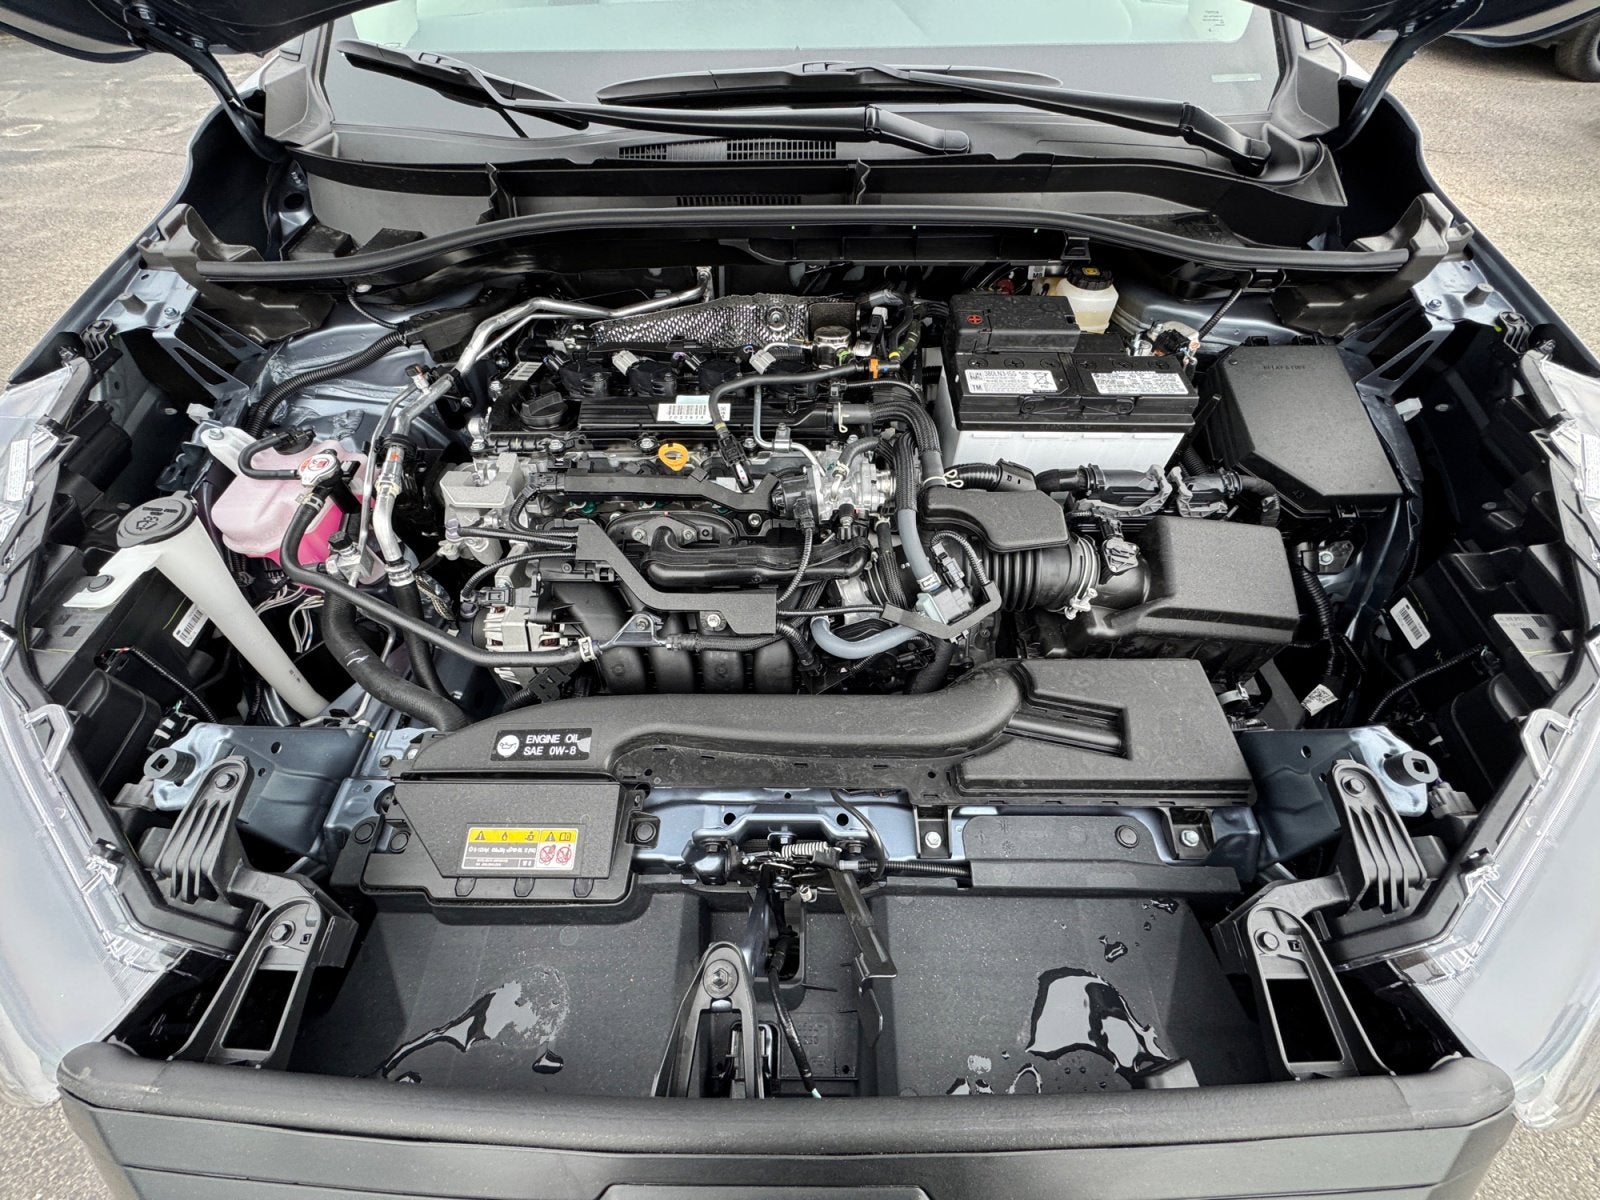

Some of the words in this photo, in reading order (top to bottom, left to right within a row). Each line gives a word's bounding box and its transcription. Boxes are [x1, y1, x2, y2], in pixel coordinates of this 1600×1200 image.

[526, 734, 561, 744] ENGINE
[565, 734, 580, 743] OIL
[523, 746, 544, 756] SAE
[549, 746, 577, 755] 0W-8
